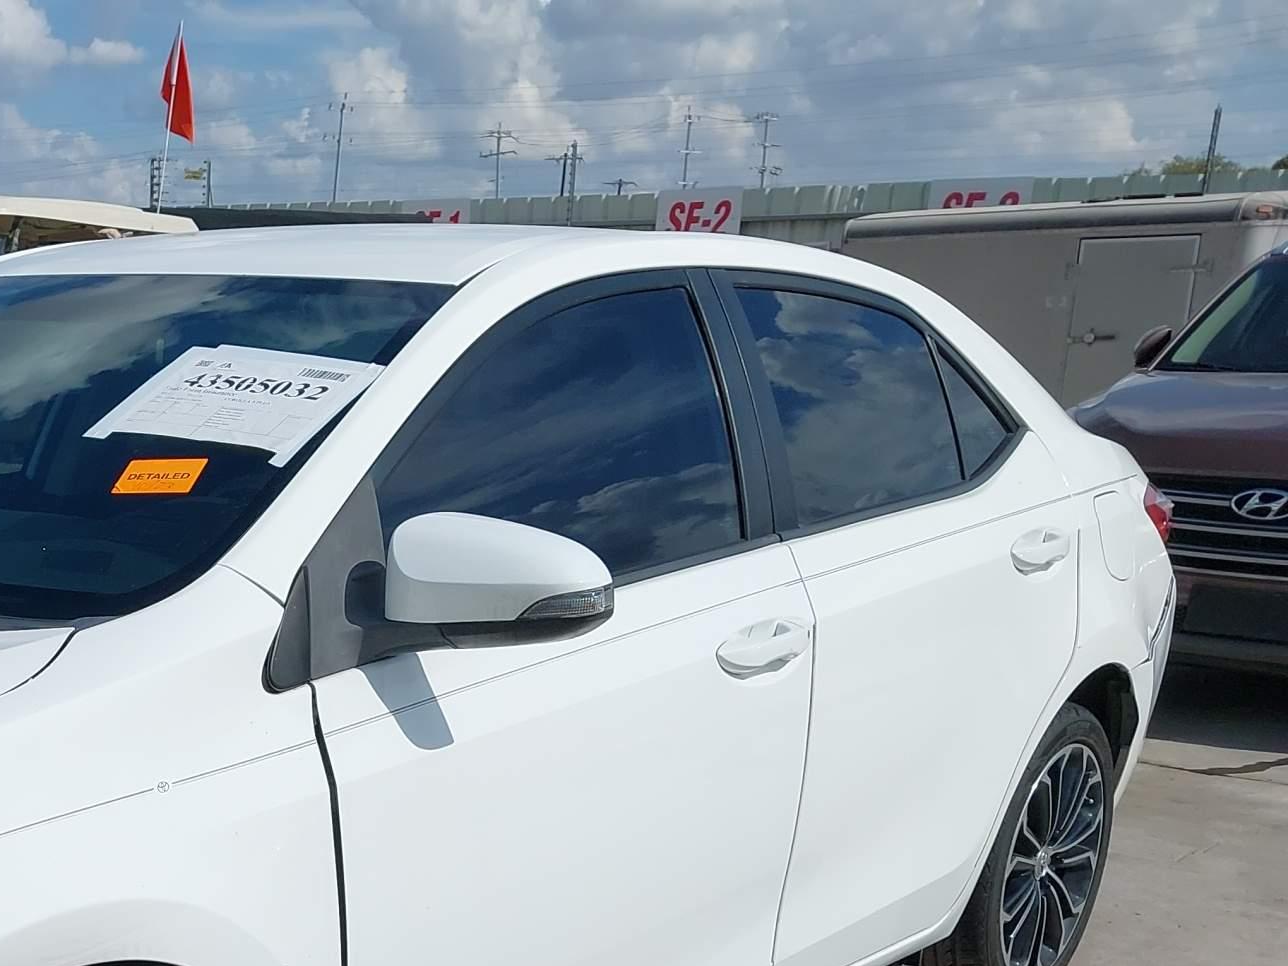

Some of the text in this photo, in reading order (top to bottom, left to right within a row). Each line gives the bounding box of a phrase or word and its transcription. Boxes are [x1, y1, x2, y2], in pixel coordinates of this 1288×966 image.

[669, 199, 732, 233] SF-2
[183, 373, 330, 401] 43505032
[127, 472, 191, 481] DETAILED
